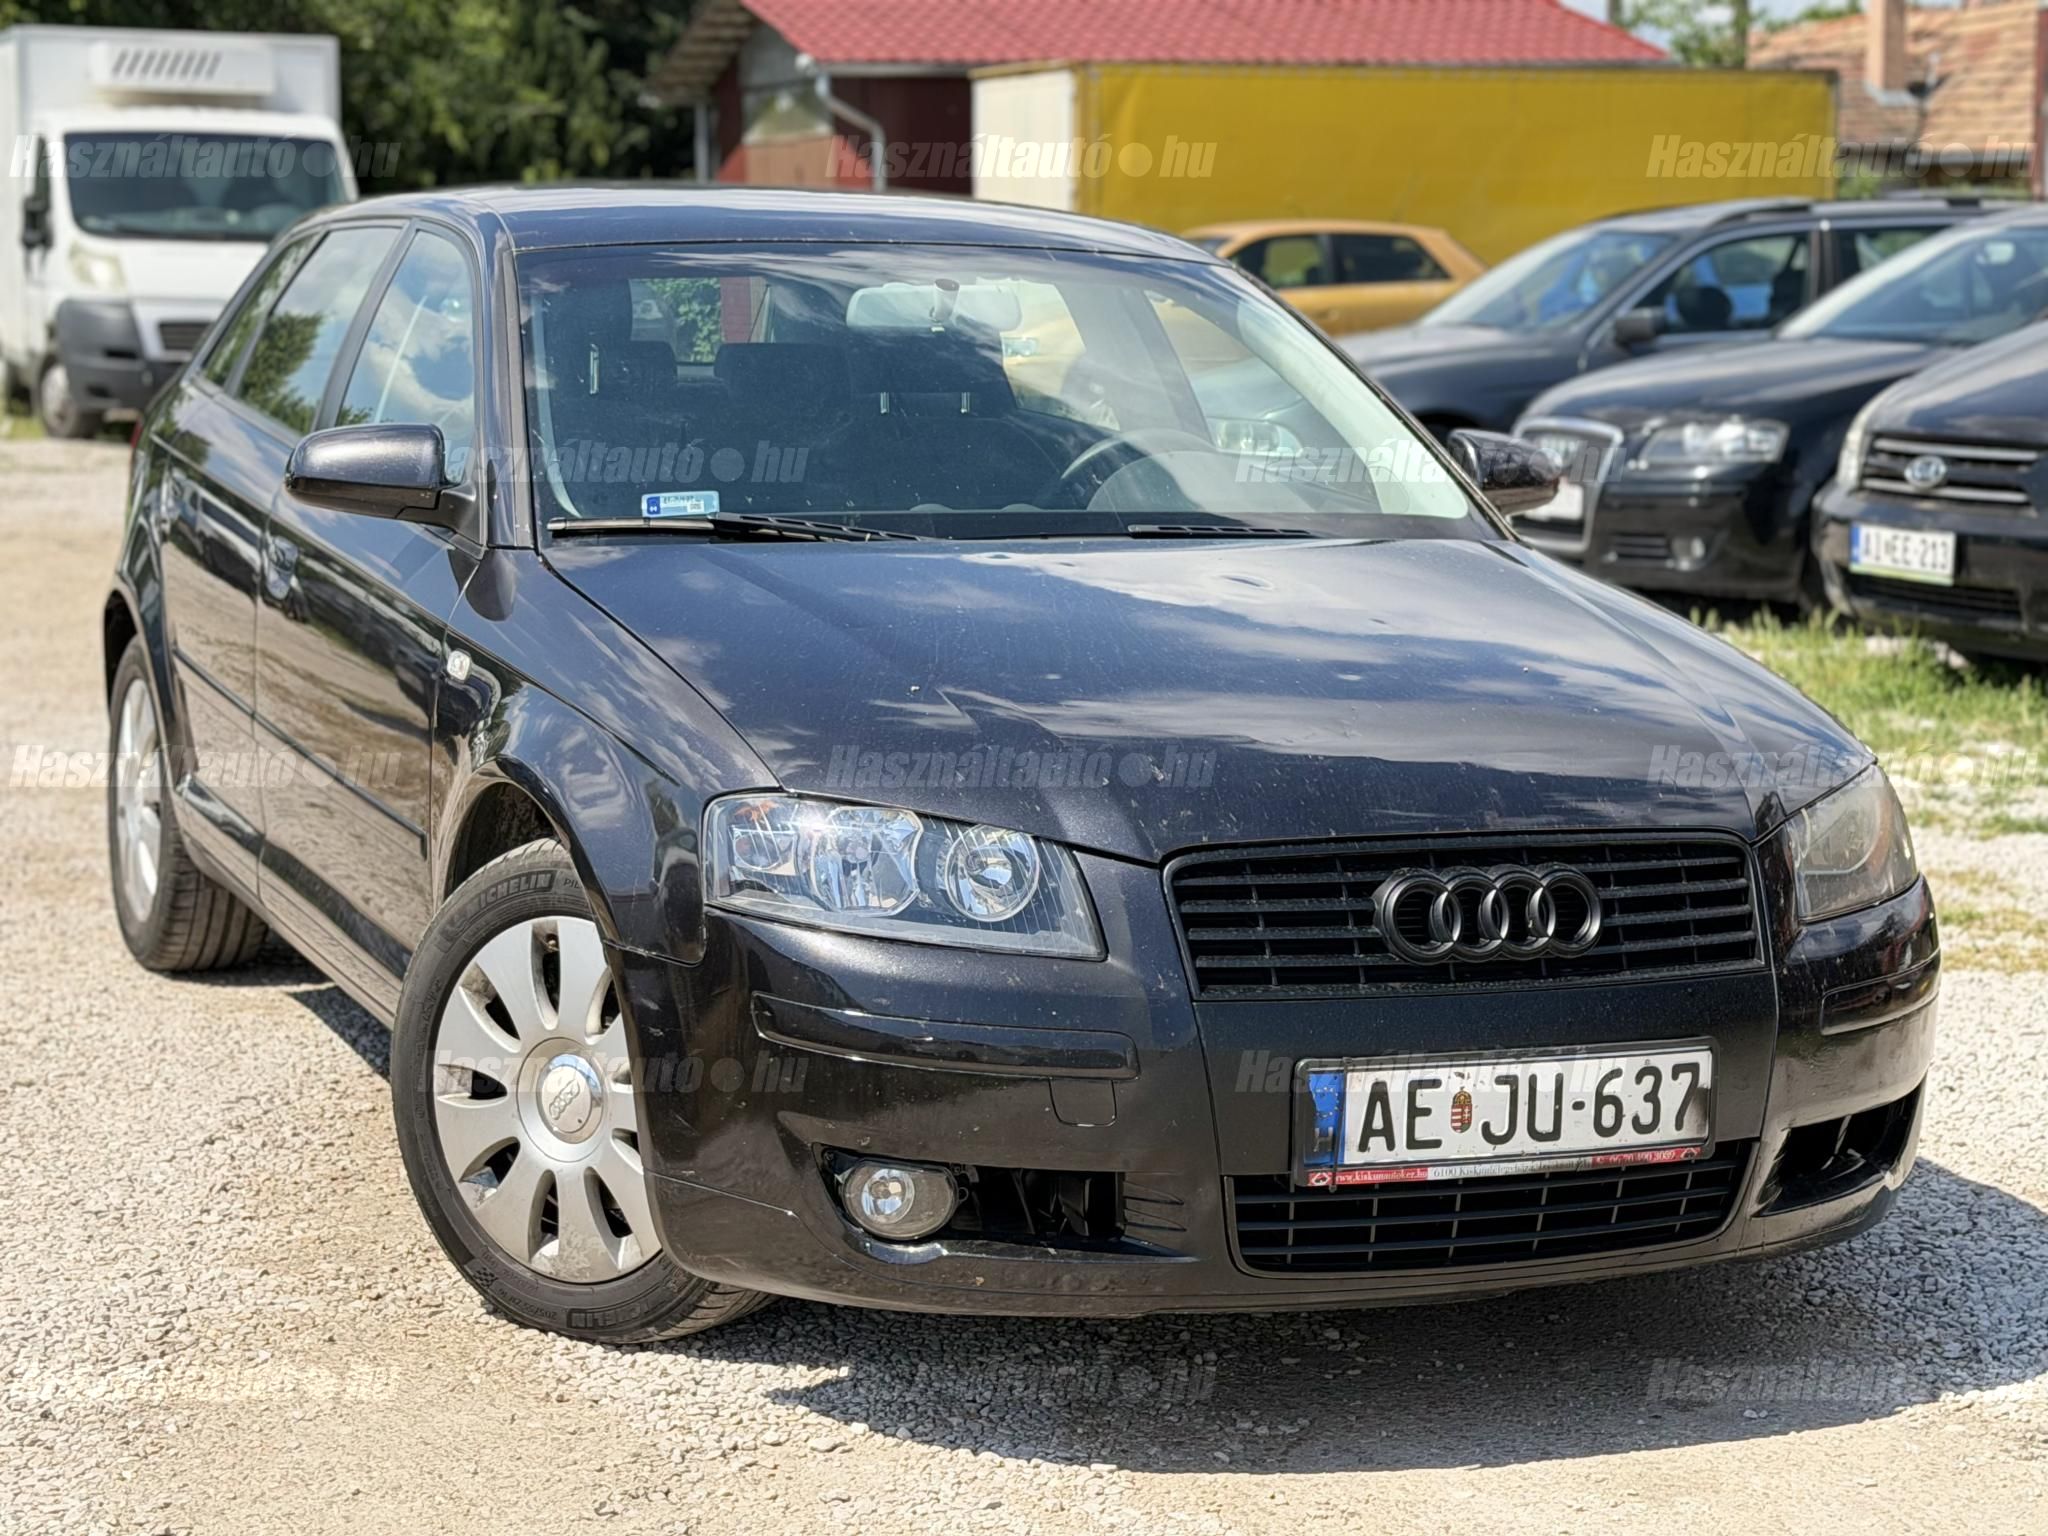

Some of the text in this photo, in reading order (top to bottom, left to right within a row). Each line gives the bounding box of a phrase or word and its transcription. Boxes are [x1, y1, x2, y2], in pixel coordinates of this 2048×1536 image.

[1358, 1062, 1701, 1153] AE JU-637
[1433, 1168, 1458, 1178] 6100
